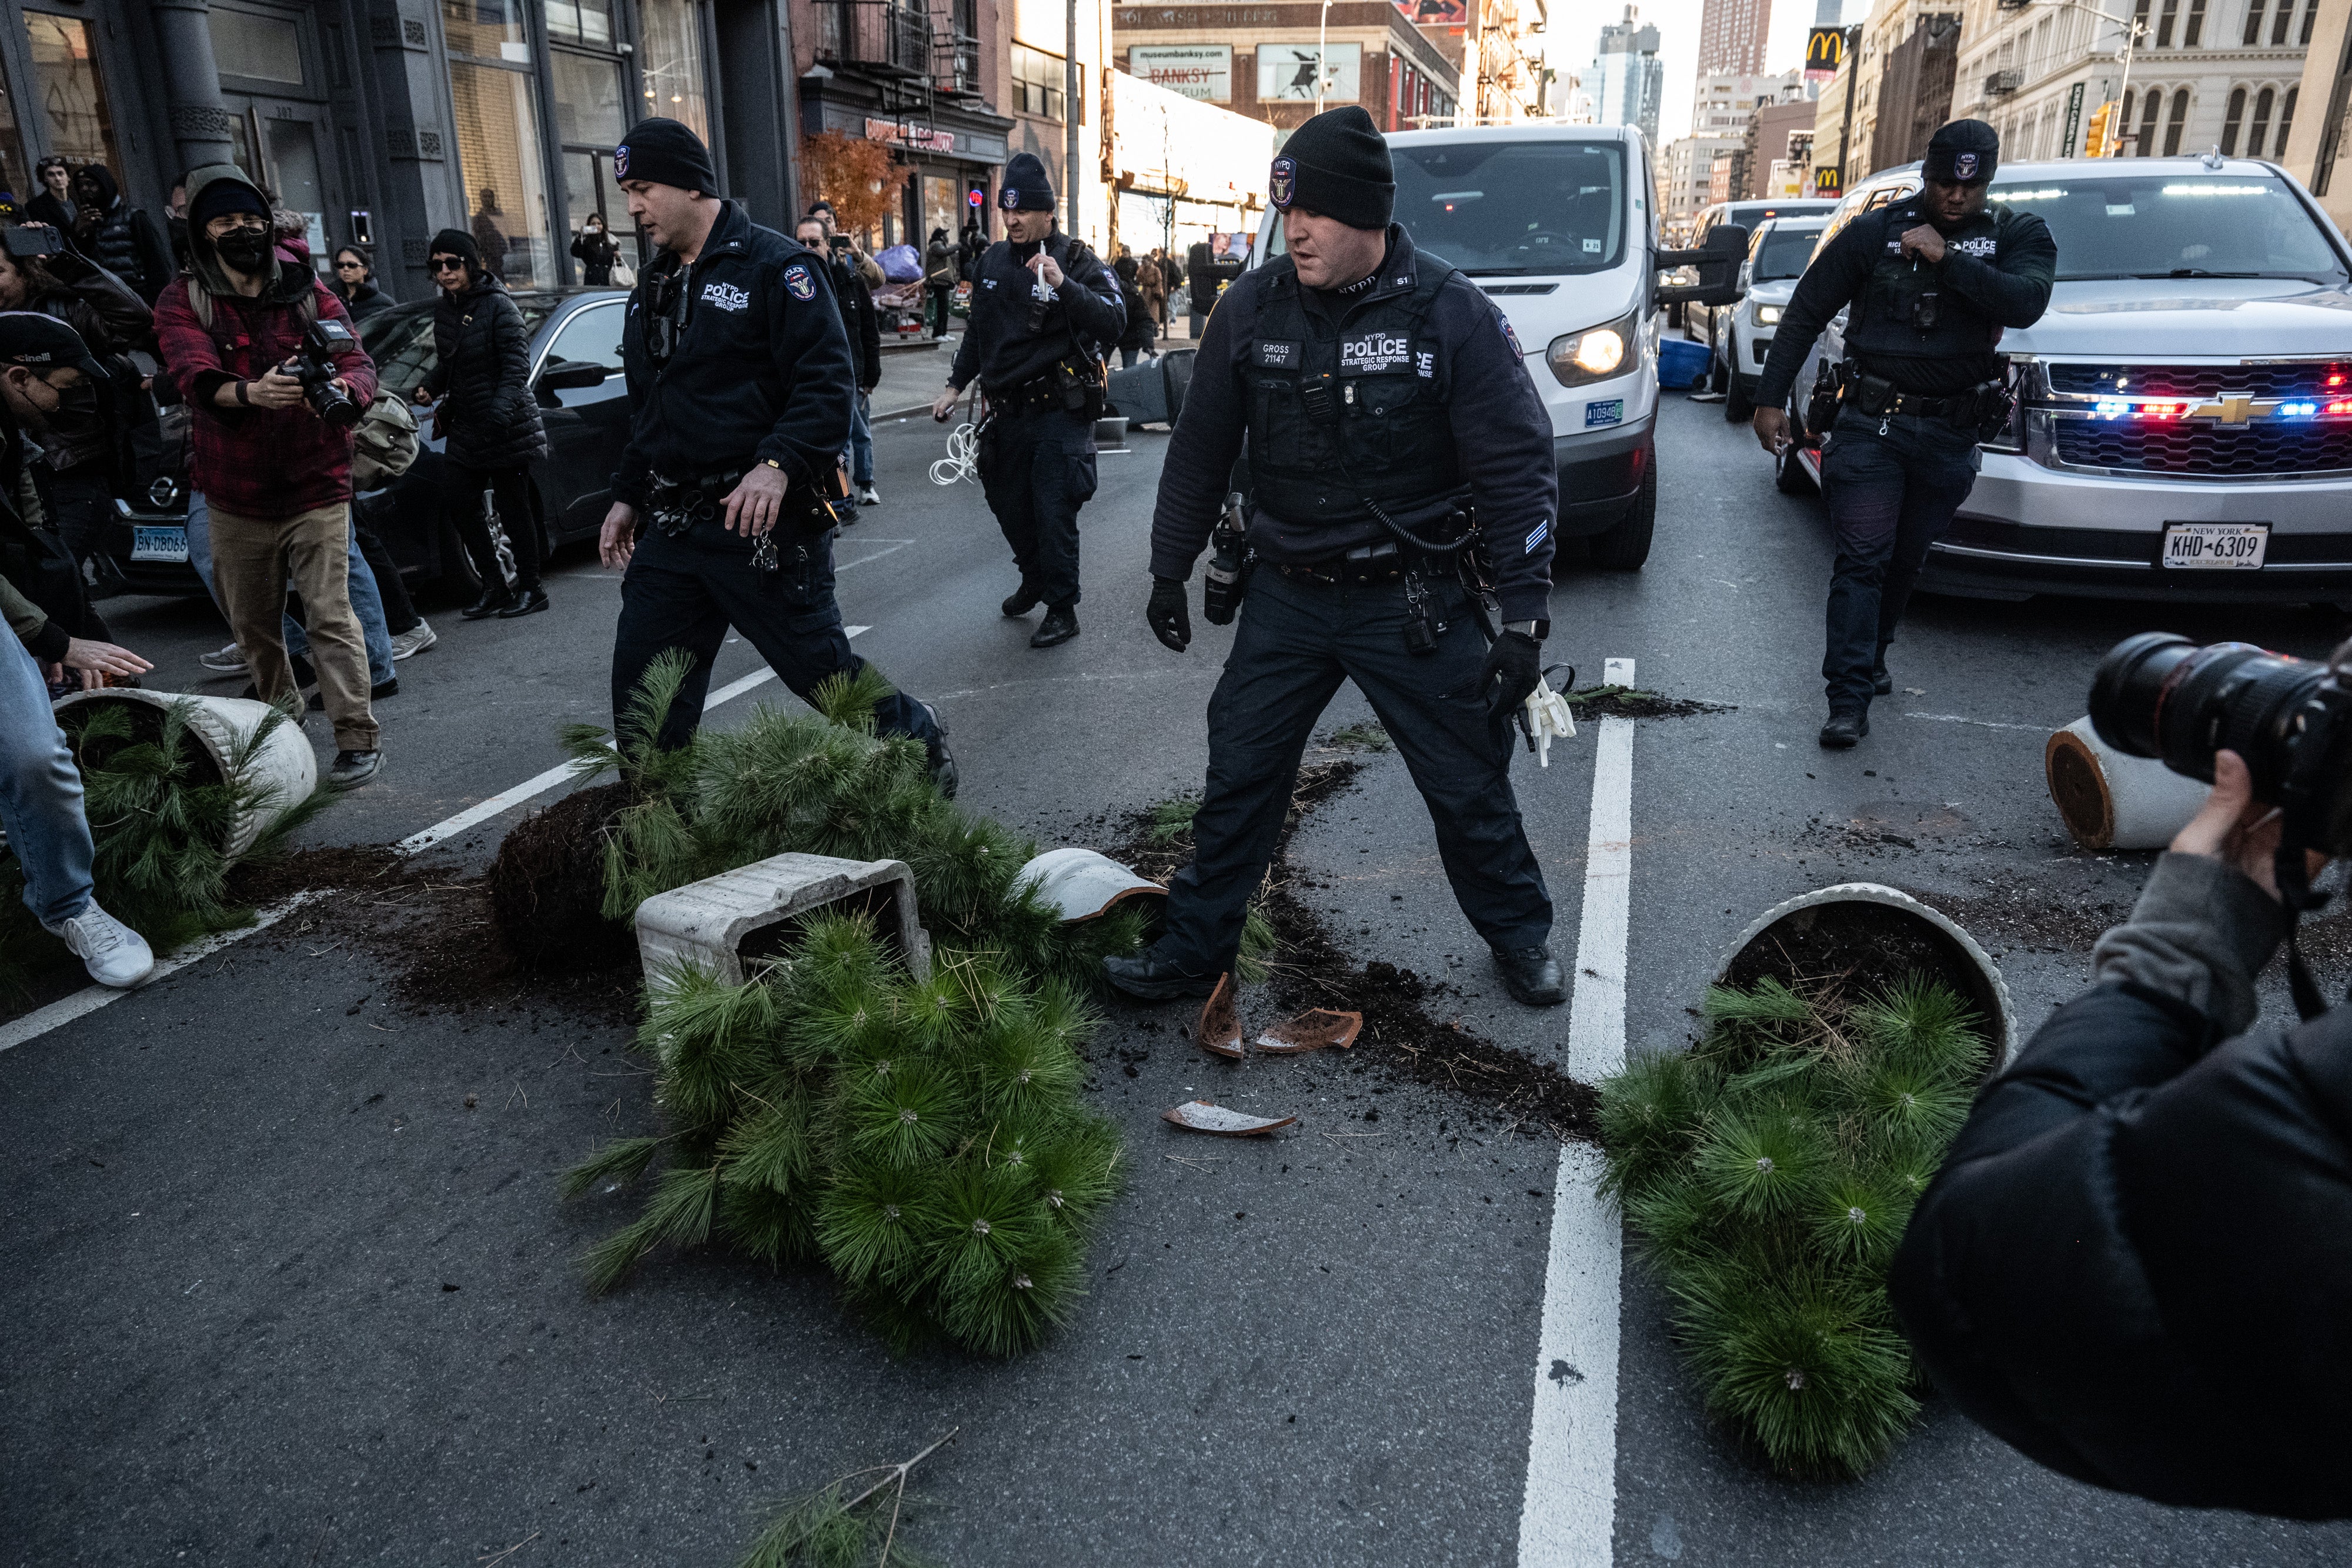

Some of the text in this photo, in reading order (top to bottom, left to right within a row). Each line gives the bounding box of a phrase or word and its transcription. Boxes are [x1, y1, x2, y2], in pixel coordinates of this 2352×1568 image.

[1140, 49, 1223, 59] museumbanksy.com
[1151, 68, 1211, 85] BANKSY
[1173, 87, 1211, 98] EUM
[2064, 85, 2083, 158] SOHO GARDEN HO
[65, 155, 85, 165] BLUE
[1275, 161, 1290, 169] NYPD
[1962, 240, 1996, 250] POLICE
[784, 267, 806, 280] POLICE
[1338, 276, 1376, 294] NYPD
[1396, 277, 1408, 285] S1
[722, 282, 739, 293] NYPD
[703, 284, 750, 304] POLICE
[701, 295, 749, 309] STRATEGIC RESPONSE
[714, 302, 734, 312] GROUP
[1365, 333, 1386, 342] NYPD
[1262, 344, 1289, 354] GROSS
[1343, 339, 1407, 359] POLICE
[1265, 354, 1286, 365] 21147
[1341, 355, 1409, 366] STRATEGIC RESPONSE
[1362, 363, 1387, 372] GROUP
[2171, 536, 2258, 557] KHD 6309
